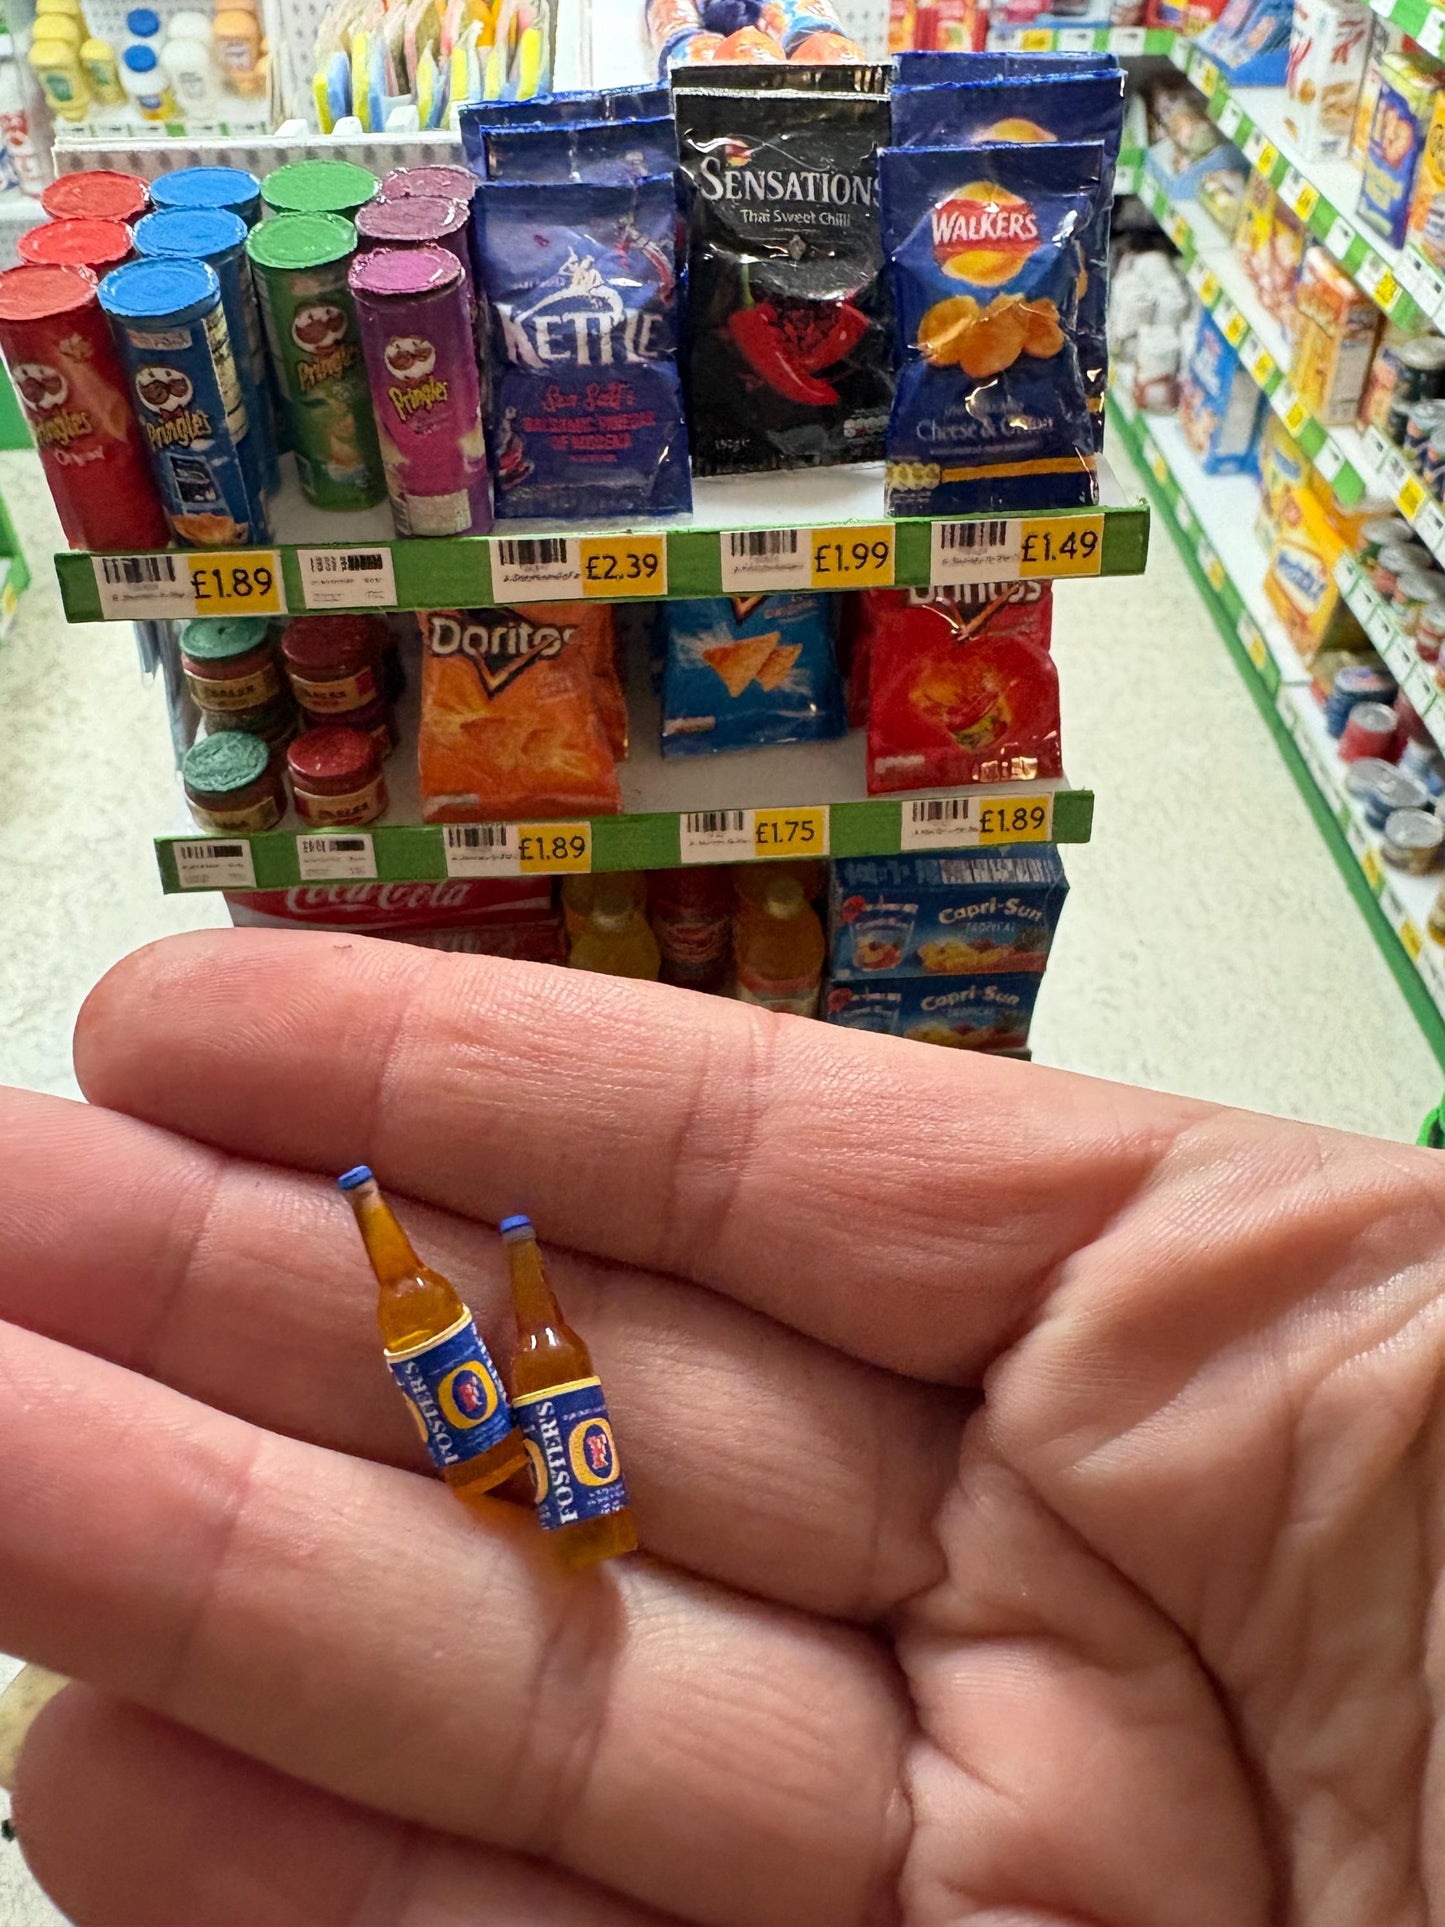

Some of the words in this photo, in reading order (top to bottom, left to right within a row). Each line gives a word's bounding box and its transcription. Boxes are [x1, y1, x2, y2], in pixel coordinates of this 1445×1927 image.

[740, 208, 771, 224] Thai
[773, 209, 816, 225] Sweet
[819, 212, 851, 228] Chilli
[931, 210, 1038, 246] WALKERS
[493, 301, 664, 371] KETTLE
[145, 409, 212, 454] Pringles
[814, 541, 889, 573] £1.99
[1021, 528, 1098, 562] £1.49
[190, 567, 272, 599] £1.89
[585, 553, 658, 581] £2.39
[755, 820, 815, 844] £1.75
[979, 806, 1045, 833] £1.89
[518, 835, 586, 860] £1.89
[938, 896, 1043, 925] Capri-Sun
[535, 1401, 589, 1525] FOSTER'S
